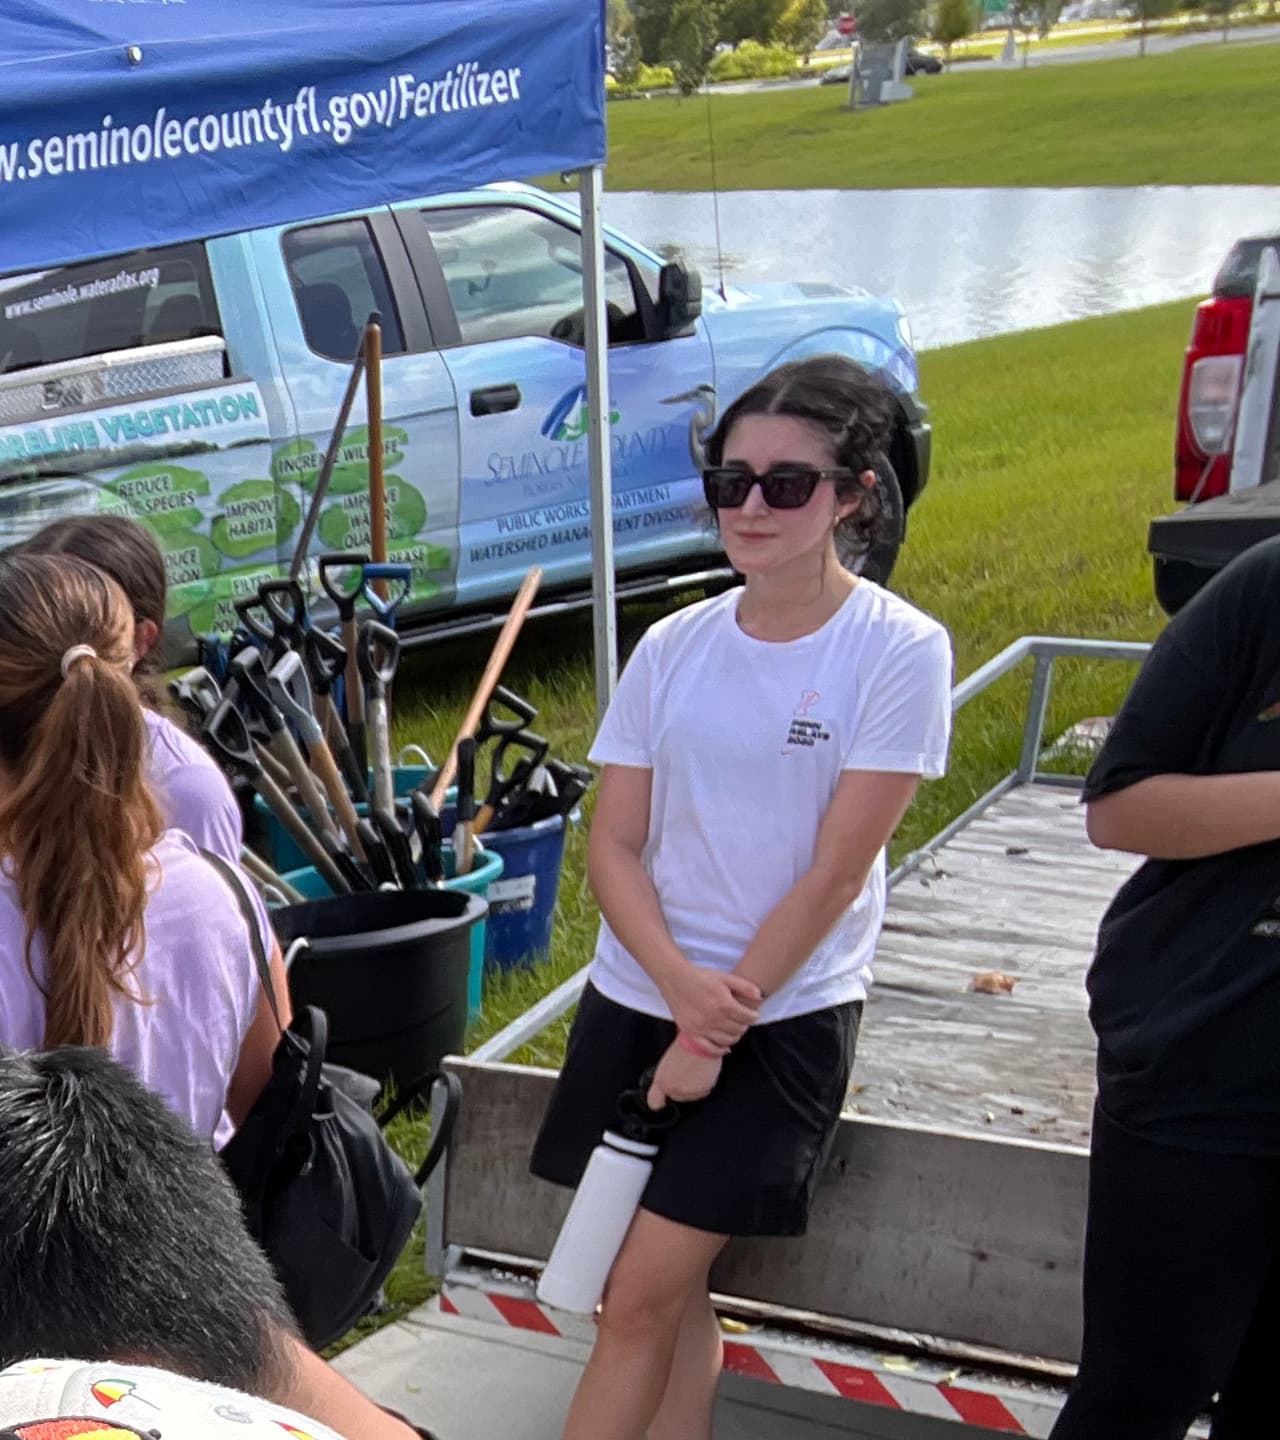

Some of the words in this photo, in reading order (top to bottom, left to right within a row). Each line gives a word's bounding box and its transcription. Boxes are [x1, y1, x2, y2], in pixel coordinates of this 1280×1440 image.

[98, 392, 260, 444] VEGETATION
[120, 475, 170, 498] REDUCE
[145, 490, 195, 514] SPECIES
[229, 515, 279, 538] HABITA
[497, 510, 545, 535] PUBLIC
[544, 500, 589, 528] WORKS
[469, 537, 549, 562] WATERSHED
